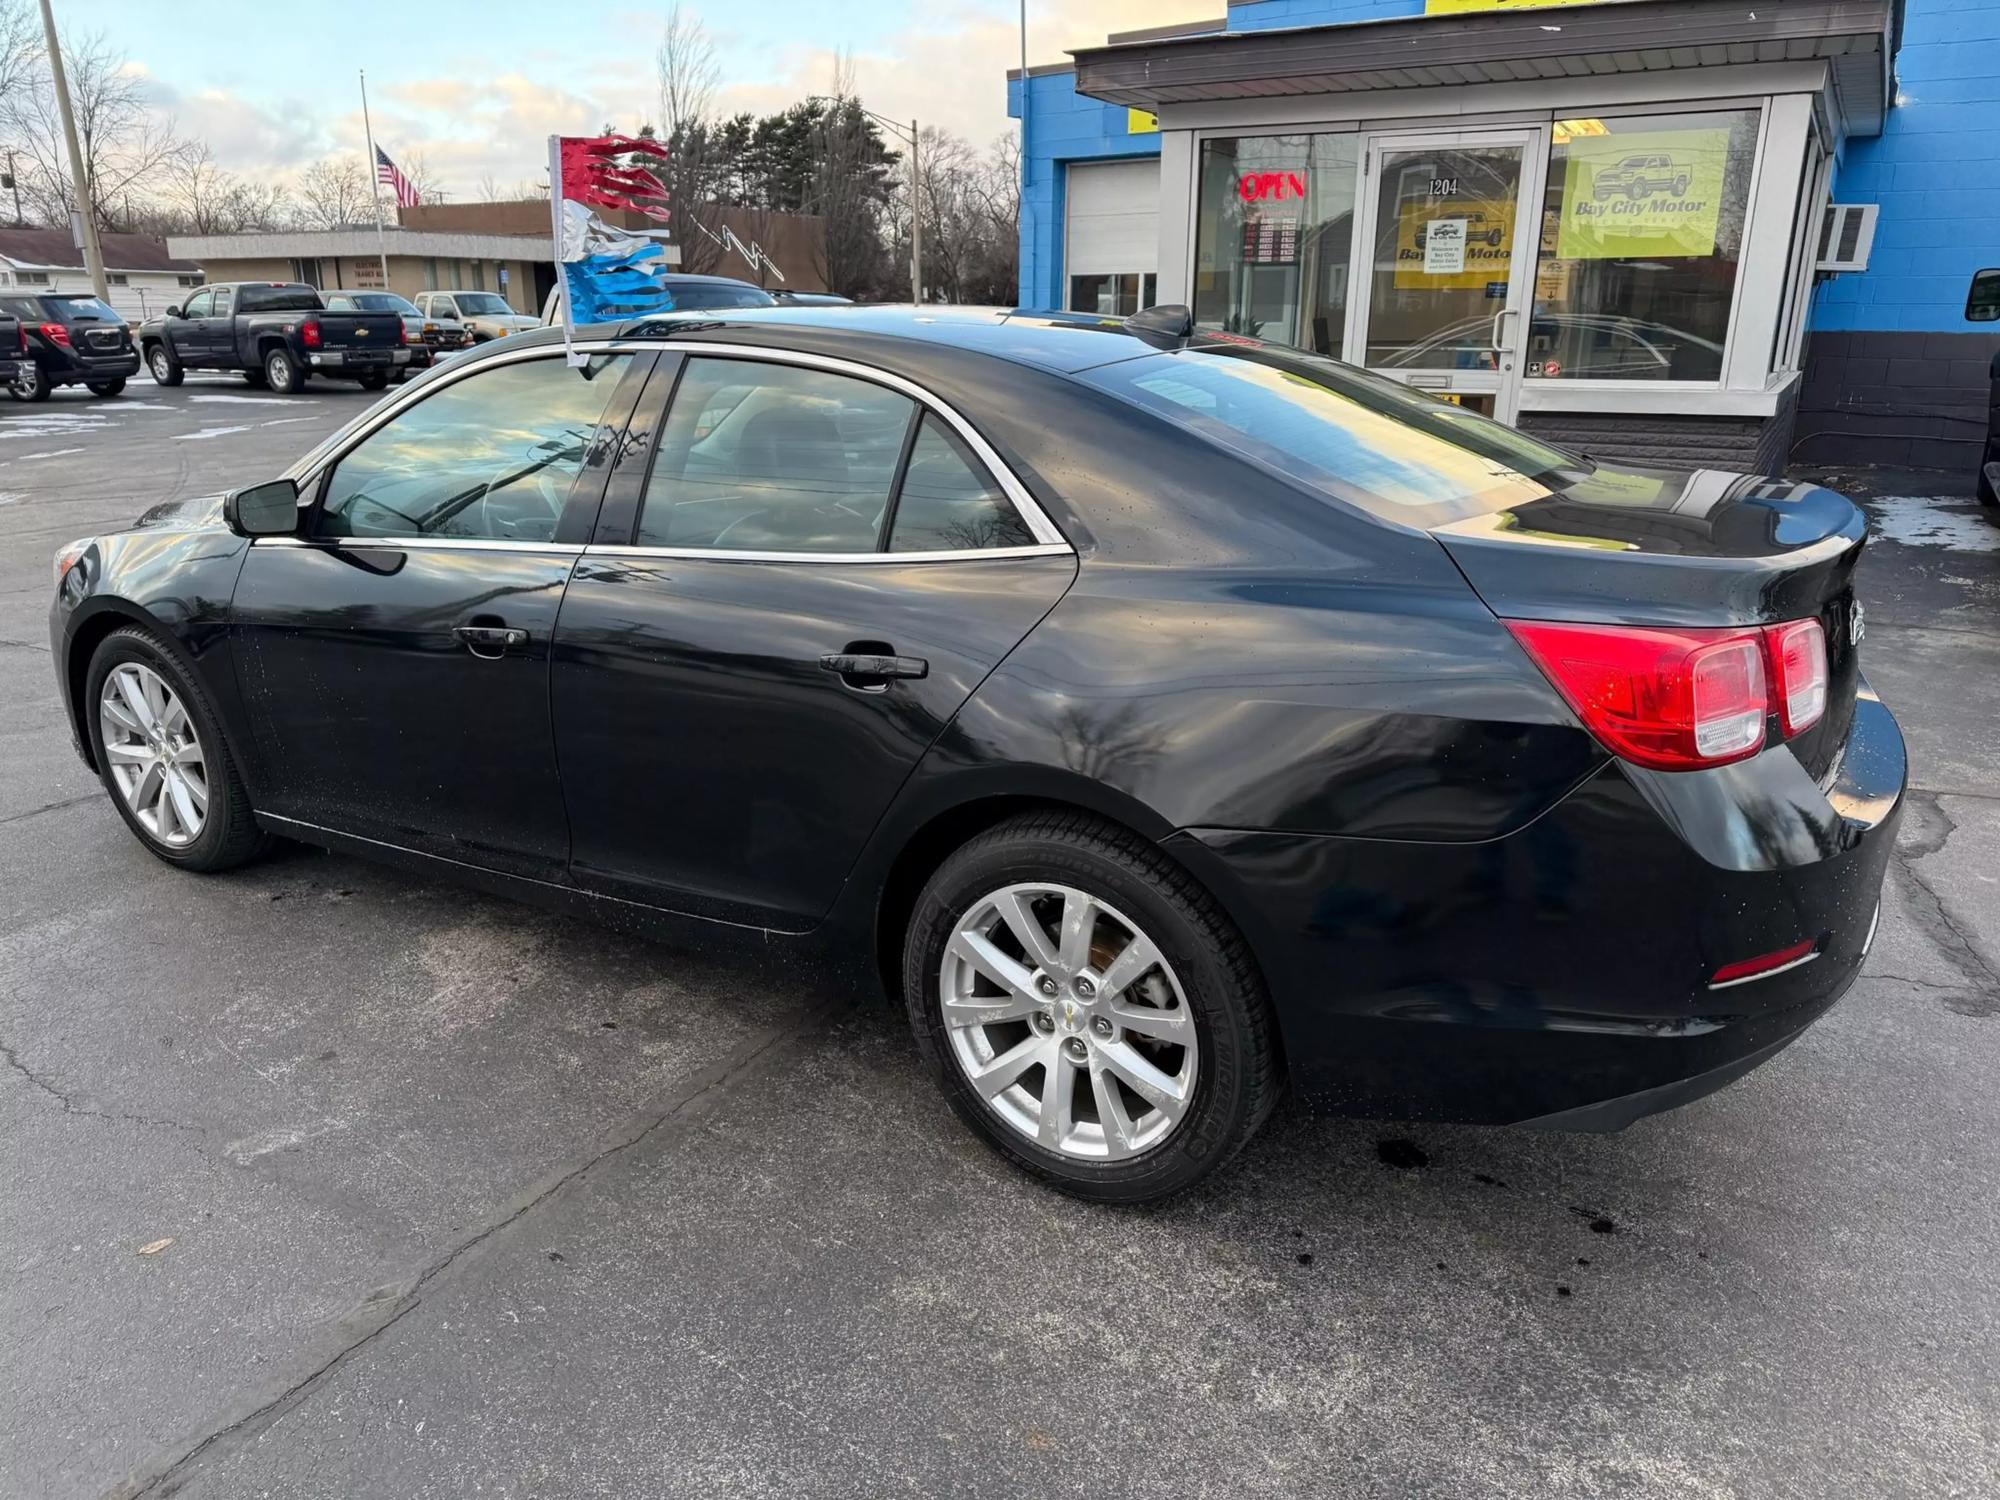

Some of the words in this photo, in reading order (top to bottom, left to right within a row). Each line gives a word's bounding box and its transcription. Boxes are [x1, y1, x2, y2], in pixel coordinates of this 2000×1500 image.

[1239, 172, 1306, 202] OPEN
[1428, 179, 1458, 196] 1204
[1576, 201, 1608, 218] Bay
[1611, 200, 1647, 216] City
[1648, 199, 1707, 213] Motor
[1398, 248, 1425, 261] Bay
